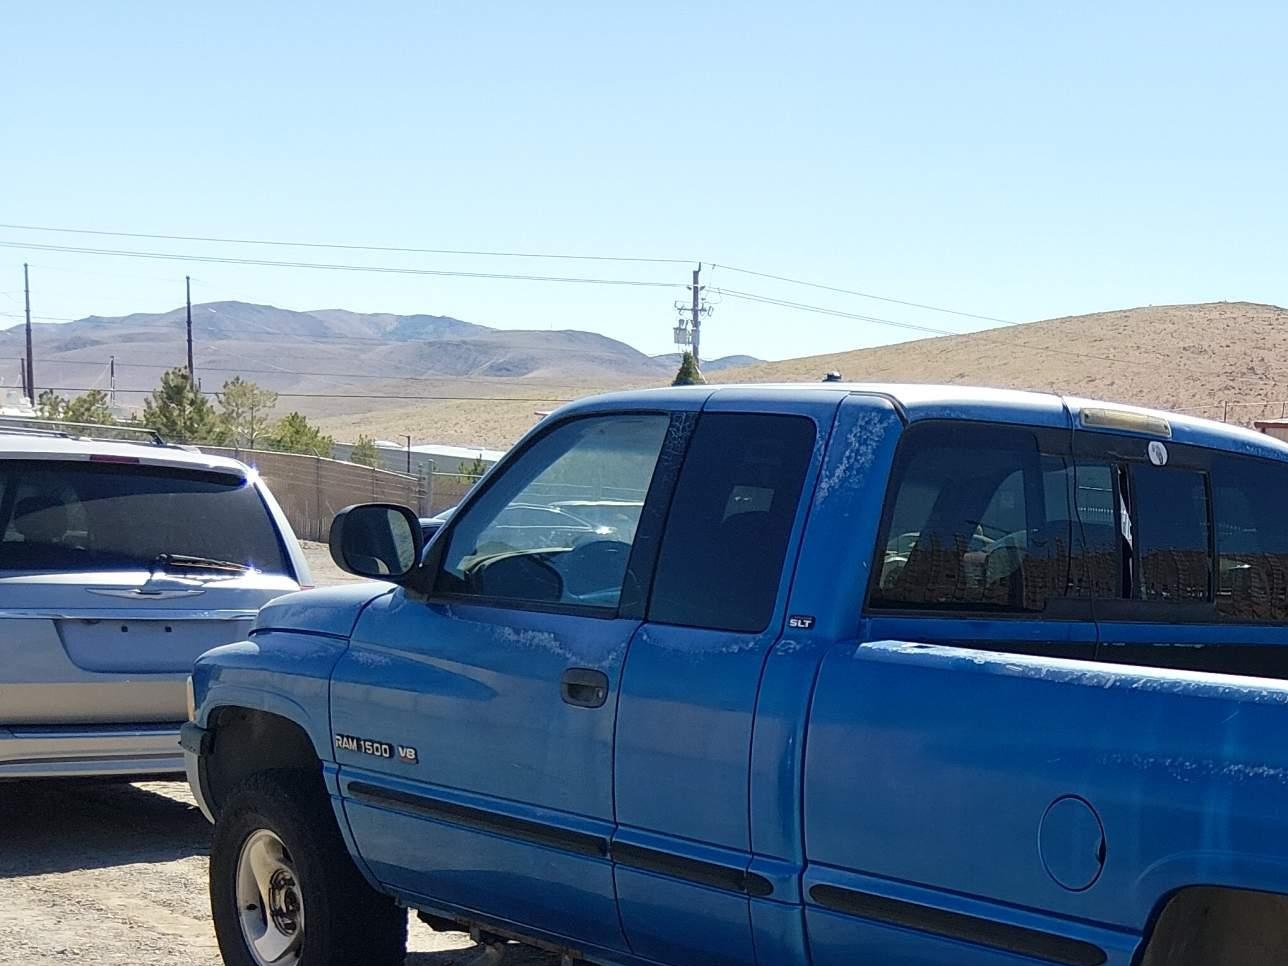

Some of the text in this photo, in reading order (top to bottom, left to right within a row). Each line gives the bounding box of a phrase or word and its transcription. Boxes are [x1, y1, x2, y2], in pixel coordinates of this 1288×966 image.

[790, 618, 812, 628] SLT
[335, 735, 416, 759] RAM 1500 V8
